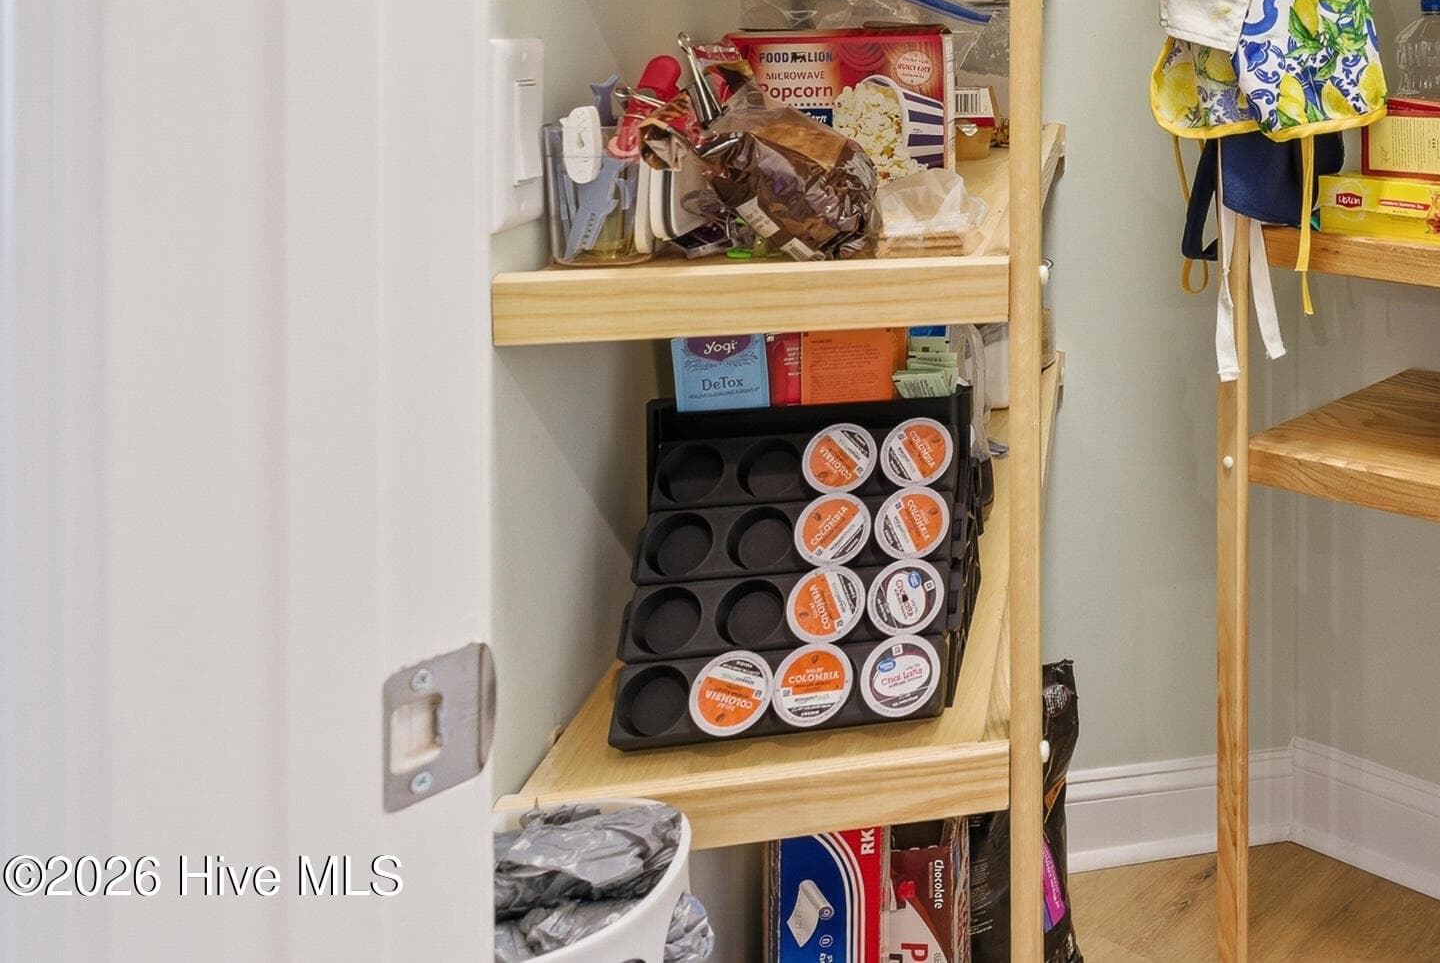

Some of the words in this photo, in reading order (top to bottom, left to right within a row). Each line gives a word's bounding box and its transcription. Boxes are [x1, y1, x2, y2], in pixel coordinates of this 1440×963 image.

[759, 52, 789, 64] FOOD
[807, 51, 833, 63] LION
[766, 70, 825, 81] MICROWAVE
[759, 84, 833, 101] Popcorn
[702, 376, 744, 391] DeTox
[788, 670, 840, 685] COLOMBIA
[705, 690, 753, 710] COLOMBIA
[933, 859, 944, 910] Chocolate
